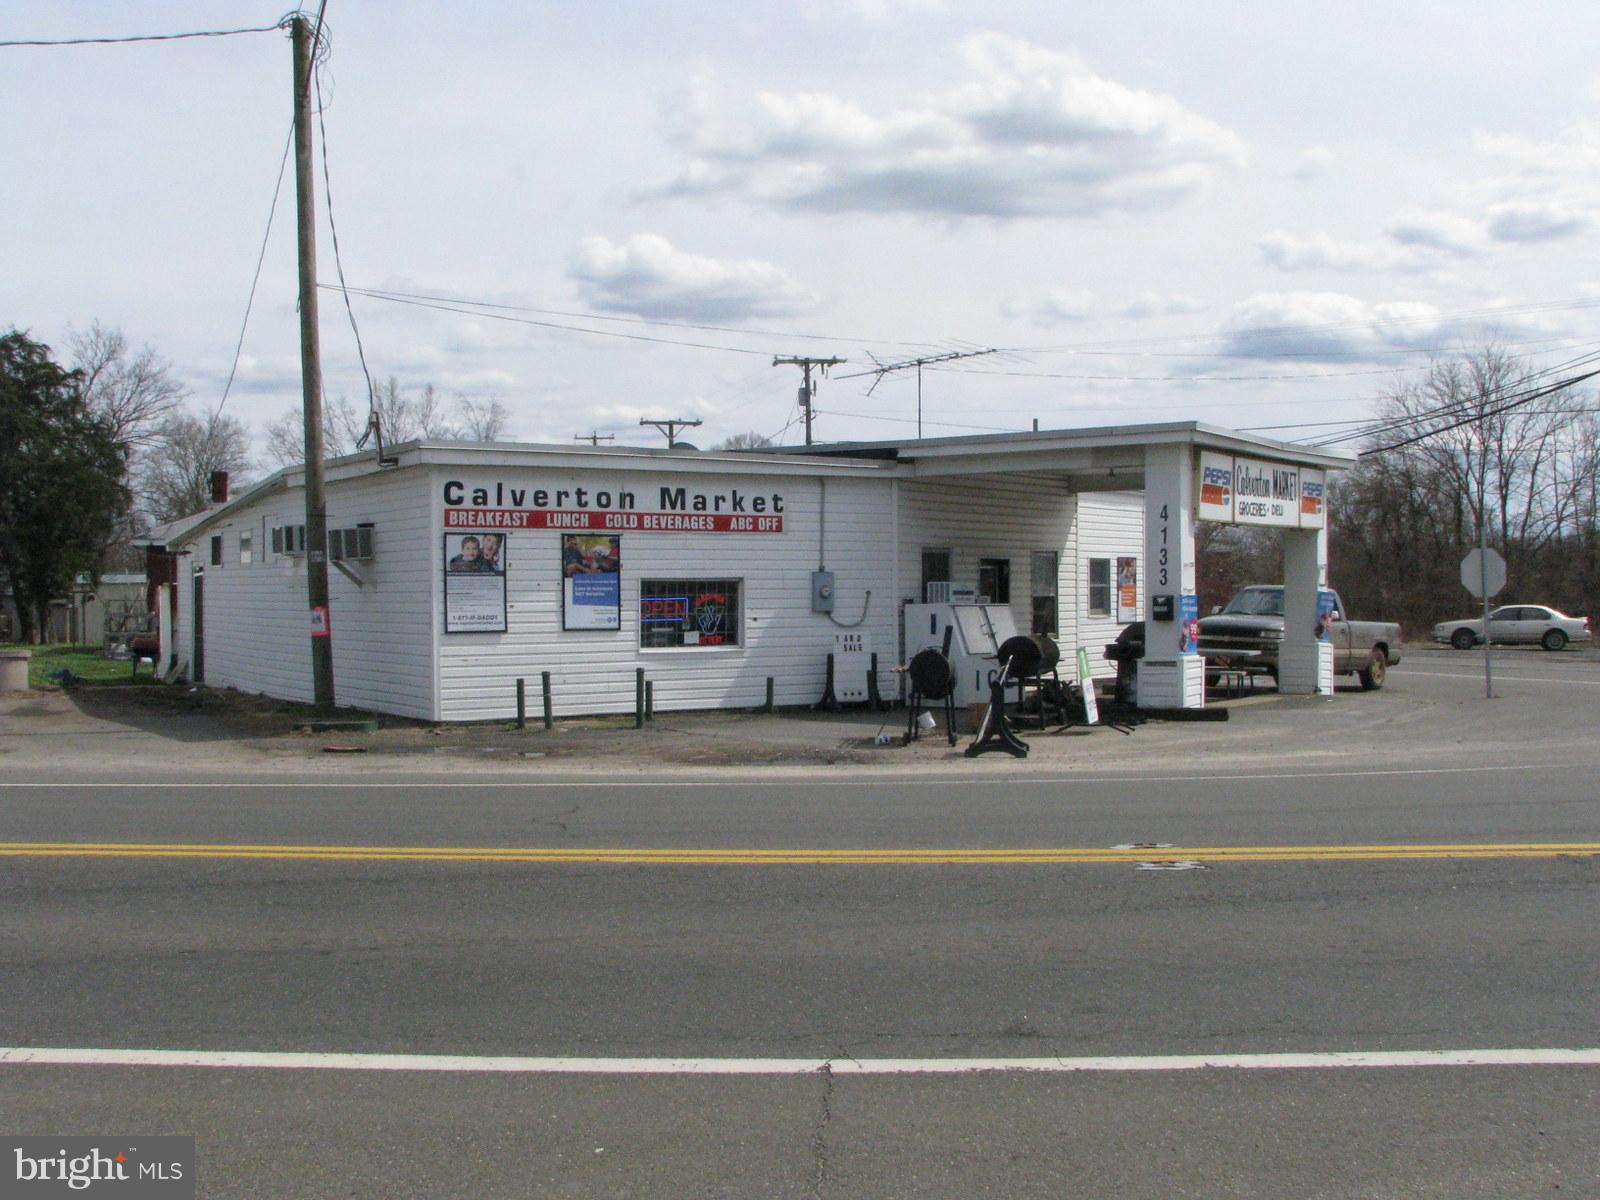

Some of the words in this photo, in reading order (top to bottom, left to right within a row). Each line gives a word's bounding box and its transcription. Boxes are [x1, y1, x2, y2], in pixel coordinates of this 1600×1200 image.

[1204, 467, 1231, 486] PEPSI
[1236, 465, 1270, 498] Calverton
[1272, 468, 1297, 502] MARKET
[443, 480, 634, 509] Calverton
[660, 487, 784, 513] Market
[1303, 481, 1323, 497] PEPSI
[1238, 501, 1266, 517] GROCERIES
[1271, 504, 1284, 516] DELI
[450, 511, 529, 527] BREAKFAST
[546, 513, 589, 527] LUNCH
[605, 514, 638, 528] COLD
[643, 515, 714, 530] BEVERAGES
[730, 517, 753, 530] ABC
[758, 518, 779, 531] OFF
[1159, 504, 1169, 586] 4133
[640, 600, 688, 618] OPEN
[843, 643, 863, 652] SALE
